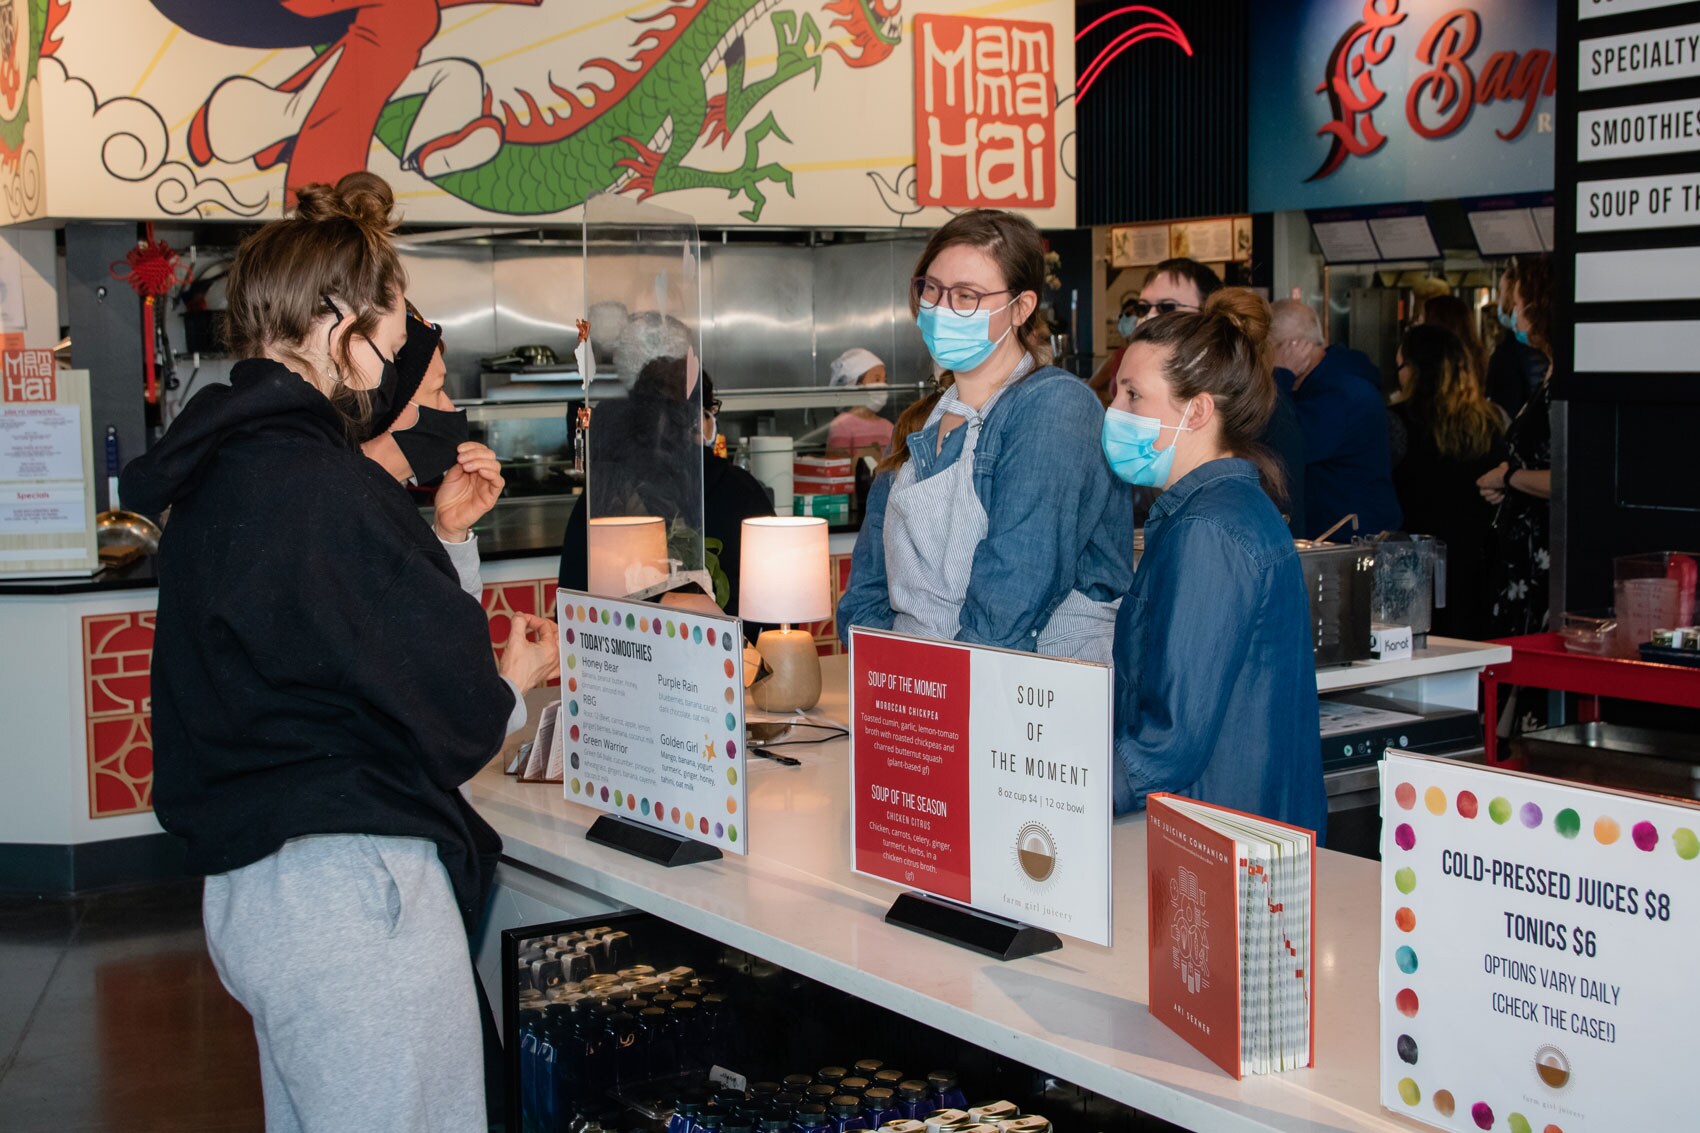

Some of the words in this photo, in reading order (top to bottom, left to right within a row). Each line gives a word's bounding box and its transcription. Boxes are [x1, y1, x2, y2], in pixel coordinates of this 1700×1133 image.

[1592, 35, 1700, 75] SPECIALTY
[928, 116, 1046, 201] Hai
[1590, 190, 1639, 218] SOUP
[1649, 187, 1673, 214] OF
[8, 377, 51, 400] Hai
[580, 632, 609, 653] TODAY'S
[611, 638, 652, 662] SMOOTHIES
[582, 656, 602, 672] Honey
[604, 661, 619, 673] Bear
[658, 674, 681, 690] Purple
[682, 680, 698, 693] Rain
[868, 670, 886, 688] SOUP
[888, 674, 897, 690] OF
[899, 676, 912, 693] THE
[914, 678, 947, 699] MOMENT
[583, 694, 597, 706] RBG
[1017, 685, 1055, 708] SOUP
[876, 700, 906, 713] MOROCCAN
[908, 707, 939, 720] CHICKPEA
[861, 712, 881, 723] Toasted
[882, 718, 900, 728] cumin,
[901, 722, 917, 731] garlic,
[918, 724, 959, 740] lemon-tomato
[1027, 722, 1044, 742] OF
[583, 733, 602, 748] Green
[603, 738, 628, 754] Warrior
[660, 734, 685, 750] Golden
[686, 740, 699, 753] Girl
[865, 726, 880, 736] broth
[880, 730, 891, 739] with
[893, 733, 913, 744] roasted
[915, 737, 942, 750] chickpeas
[943, 744, 955, 752] and
[661, 751, 678, 763] Mango,
[874, 741, 894, 753] charred
[895, 747, 921, 759] butternut
[922, 752, 943, 764] squash
[887, 757, 921, 772] (plant-based
[922, 765, 930, 775] gf)
[991, 749, 1017, 773] THE
[1025, 756, 1089, 788] MOMENT
[684, 782, 694, 791] milk
[871, 784, 889, 802] SOUP
[891, 789, 900, 805] OF
[901, 791, 915, 810] THE
[917, 796, 947, 817] SEASON
[998, 787, 1003, 797] 8
[1004, 790, 1012, 799] oz
[1014, 792, 1027, 803] cup
[1028, 792, 1038, 805] $4
[1045, 797, 1054, 808] 12
[1056, 802, 1065, 811] oz
[1066, 803, 1085, 815] bowl
[886, 811, 910, 825] CHICKEN
[911, 817, 931, 830] CITRUS
[869, 821, 891, 835] Chicken,
[932, 840, 952, 852] ginger,
[882, 839, 907, 851] turmeric,
[908, 845, 925, 857] herbs,
[1150, 815, 1160, 827] THE
[1162, 823, 1187, 842] JUICING
[1189, 837, 1229, 864] COMPANION
[883, 851, 902, 863] chicken
[903, 858, 920, 868] citrus
[1442, 849, 1571, 901] COLD-PRESSED
[1576, 877, 1638, 914] JUICES
[1645, 889, 1671, 922] $8
[1003, 894, 1022, 908] farm
[1024, 899, 1040, 913] girl
[1042, 902, 1073, 922] juicery
[1503, 911, 1567, 951] TONICS
[1573, 926, 1596, 958] $6
[1484, 954, 1536, 985] OPTIONS
[1540, 968, 1575, 995] VARY
[1580, 978, 1620, 1006] DAILY
[1174, 1002, 1184, 1016] ARI
[1492, 992, 1538, 1023] (CHECK
[1542, 1005, 1567, 1031] THE
[1571, 1012, 1616, 1044] CASE!)
